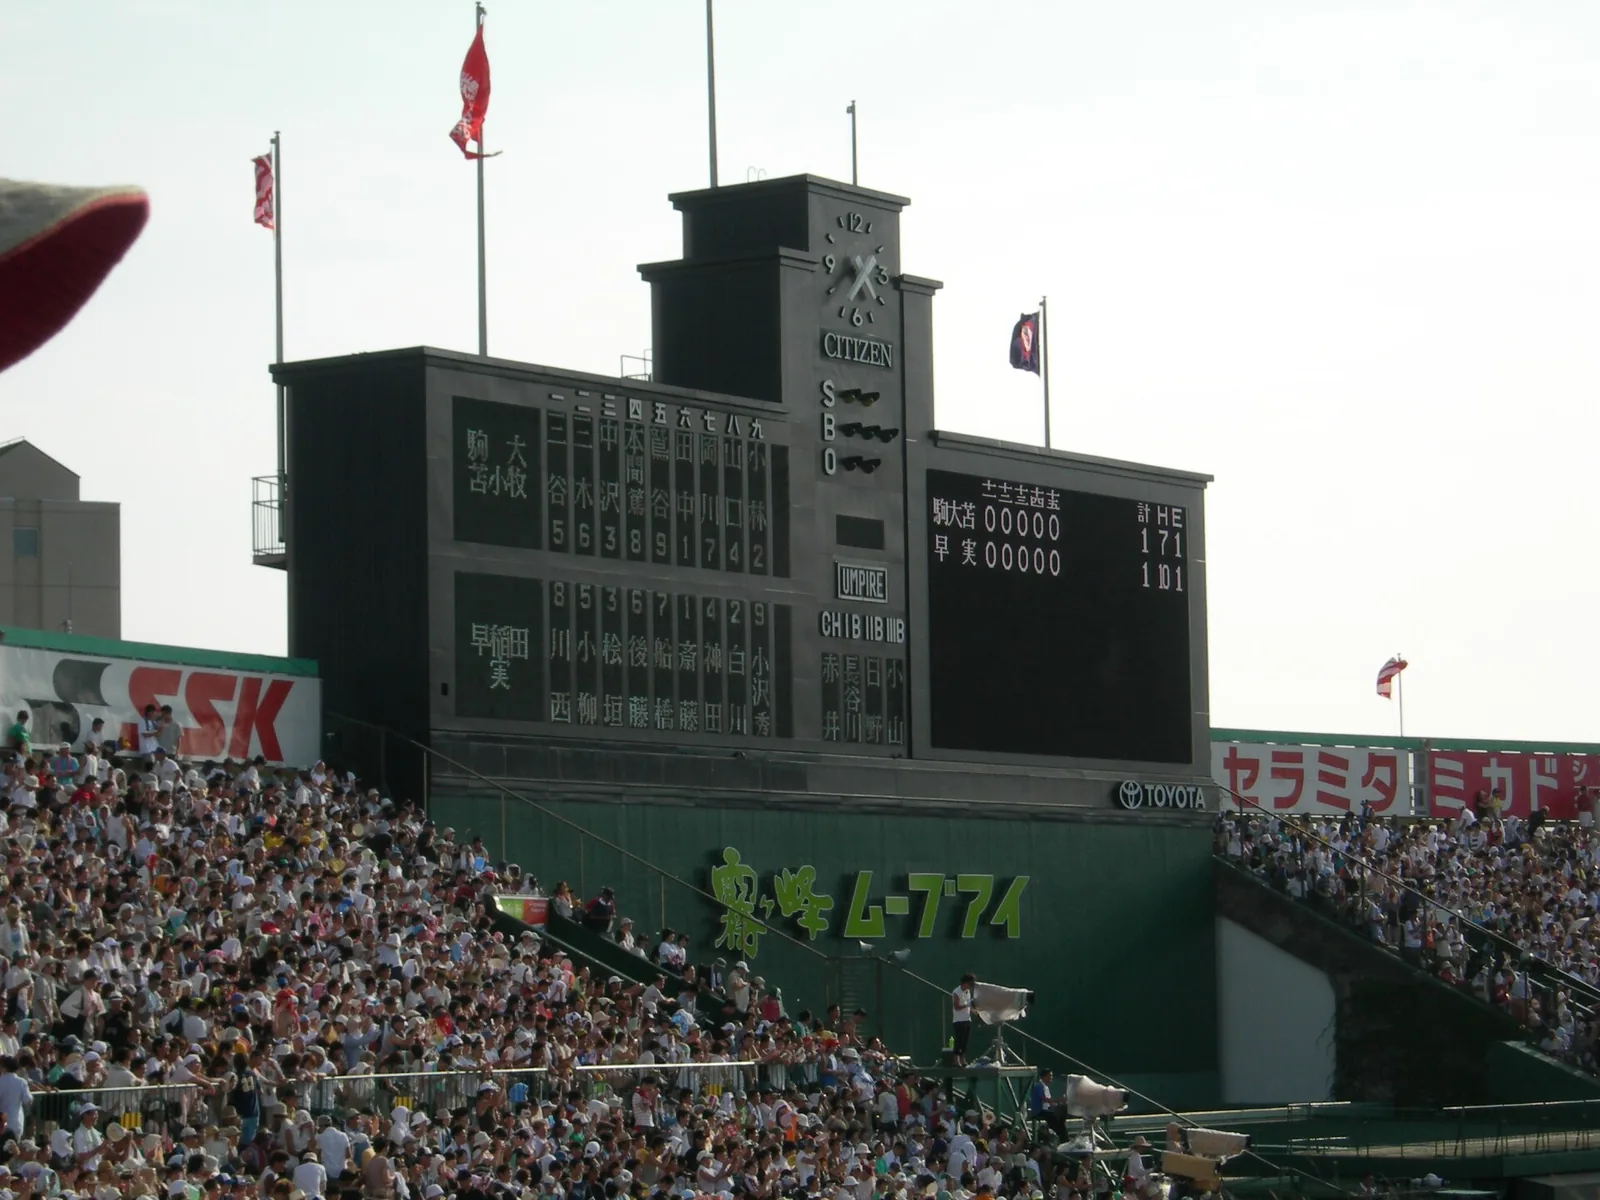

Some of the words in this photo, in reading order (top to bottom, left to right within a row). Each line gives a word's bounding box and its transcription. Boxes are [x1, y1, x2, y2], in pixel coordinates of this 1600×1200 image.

[849, 212, 864, 233] 12
[825, 255, 836, 274] 9
[876, 266, 890, 286] 3
[852, 307, 864, 327] 6
[824, 331, 893, 368] CITIZEN
[822, 379, 836, 408] S
[577, 390, 591, 412] 二
[604, 393, 617, 416] 三
[629, 398, 643, 420] 四
[654, 402, 668, 424] 五
[679, 407, 692, 427] 六
[703, 410, 716, 431] 七
[727, 414, 741, 435] 八
[751, 418, 764, 439] 九
[823, 413, 836, 441] B
[982, 480, 997, 498] 十一
[998, 482, 1013, 504] 十二
[1014, 484, 1029, 506] 十三
[1030, 487, 1044, 508] 十四
[1046, 489, 1060, 511] 十五
[1137, 502, 1151, 523] 計
[1157, 505, 1168, 526] H
[1172, 507, 1183, 529] E
[552, 519, 564, 544] 5
[579, 522, 590, 548] 6
[605, 525, 616, 550] 3
[933, 496, 976, 530] 駒大苫
[1141, 527, 1149, 553] 1
[1158, 529, 1168, 556] 7
[1174, 531, 1182, 558] 1
[630, 529, 641, 554] 8
[656, 532, 666, 556] 9
[682, 535, 689, 559] 1
[705, 538, 715, 562] 7
[730, 541, 739, 565] 4
[753, 544, 763, 568] 2
[841, 566, 884, 599] UMPIRE
[1142, 561, 1150, 588] 1
[1158, 563, 1170, 590] 10
[1175, 565, 1183, 592] 1
[554, 582, 565, 607] 8
[580, 584, 591, 609] 5
[606, 586, 617, 612] 3
[632, 589, 643, 614] 6
[657, 592, 668, 617] 7
[685, 595, 690, 620] 1
[706, 598, 716, 620] 4
[730, 600, 741, 624] 2
[754, 602, 765, 627] 9
[821, 611, 841, 637] CH
[470, 623, 529, 660] 早稲田
[118, 666, 295, 762] SSK
[1222, 746, 1398, 812] セラミタ
[1434, 757, 1558, 812] ミカド
[1145, 783, 1206, 809] TOYOTA
[844, 870, 1030, 939] ムーブアイ
